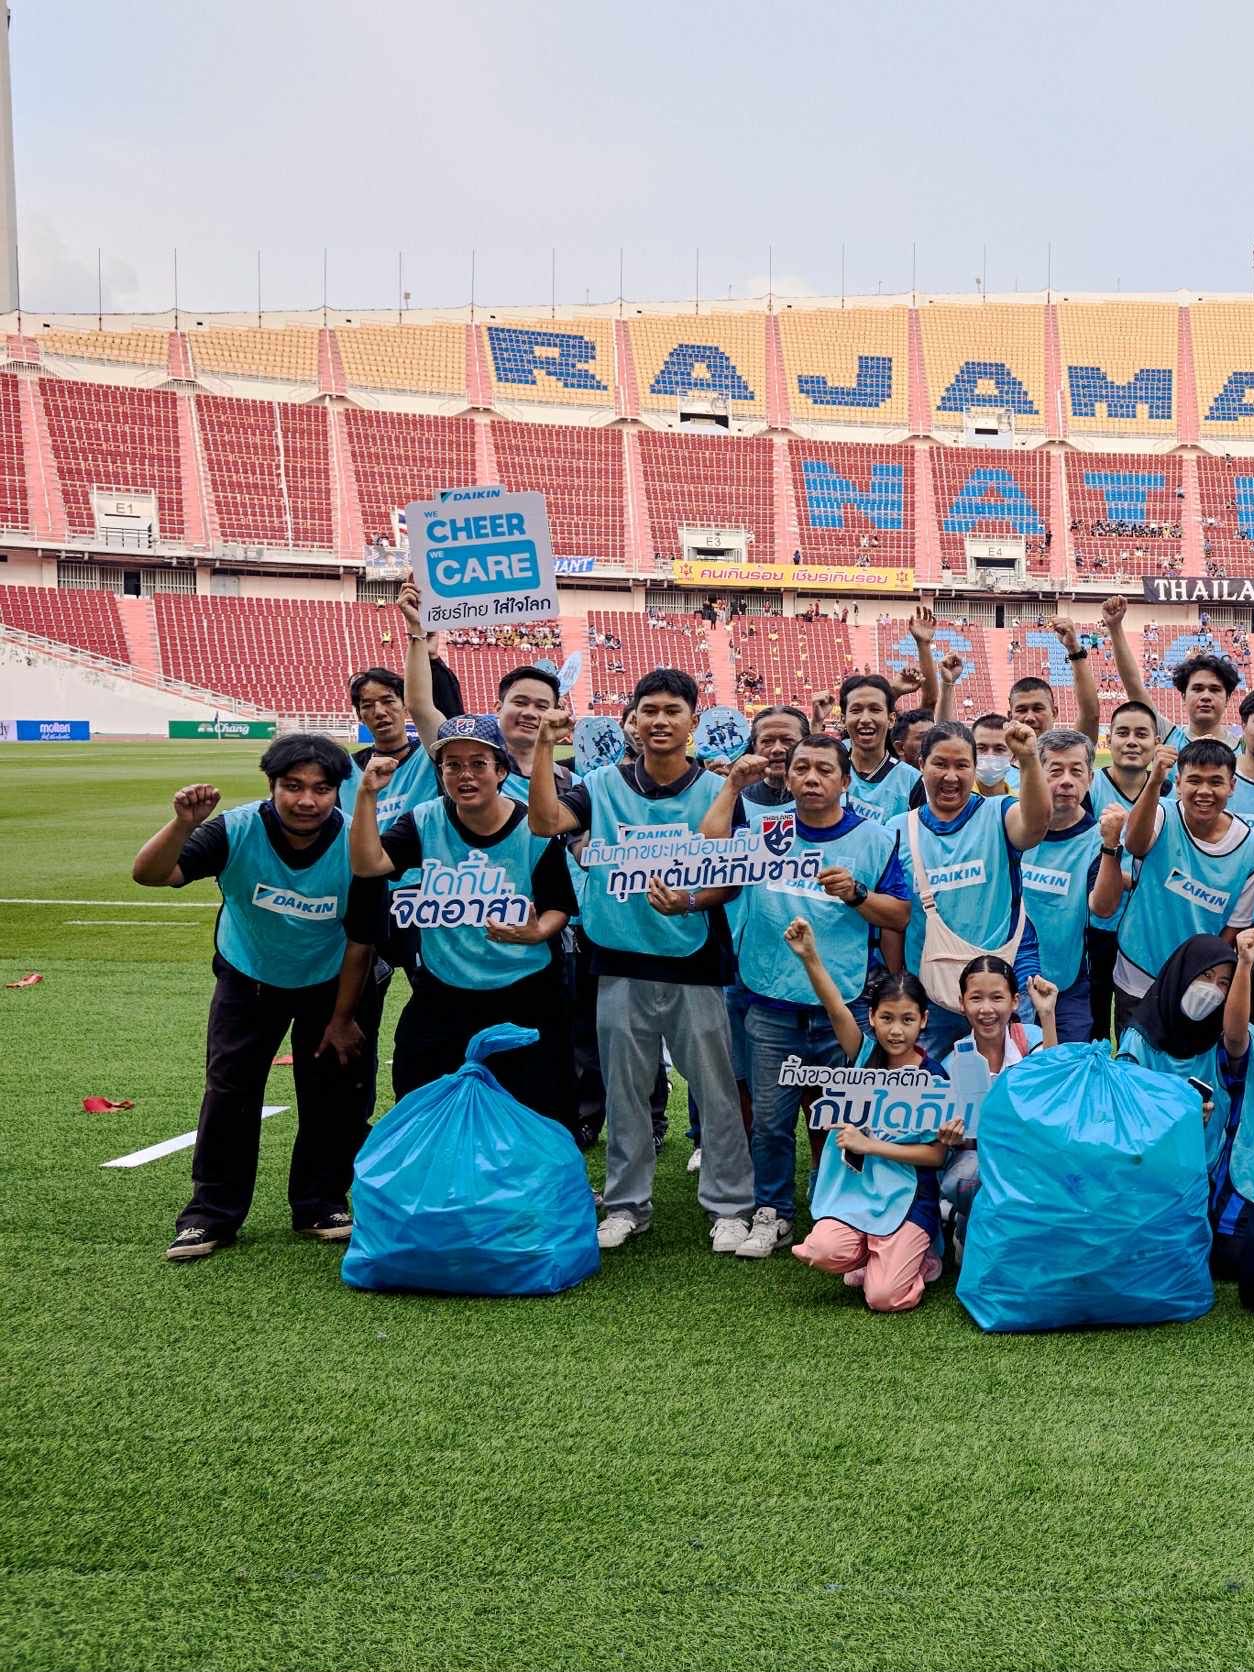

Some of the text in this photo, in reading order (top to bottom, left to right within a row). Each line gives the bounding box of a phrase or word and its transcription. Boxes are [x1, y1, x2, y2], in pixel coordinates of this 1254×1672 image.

[454, 490, 500, 501] DAIKIN
[116, 503, 134, 513] E1
[427, 513, 525, 543] CHEER
[707, 536, 722, 547] E3
[988, 547, 1003, 557] E4
[436, 553, 532, 586] CARE
[428, 597, 551, 621] เชียร์ไทย ใส่ใจโลก
[40, 723, 70, 733] molten
[214, 723, 249, 736] Chang
[637, 829, 682, 841] DAIKIN
[423, 851, 502, 897] ไดกิ้น
[930, 866, 982, 886] DAIKIN
[1022, 870, 1069, 888] AIKIN
[1182, 880, 1227, 907] DAIKIN
[273, 894, 336, 914] DAIKIN
[394, 891, 529, 925] จิตอาสา
